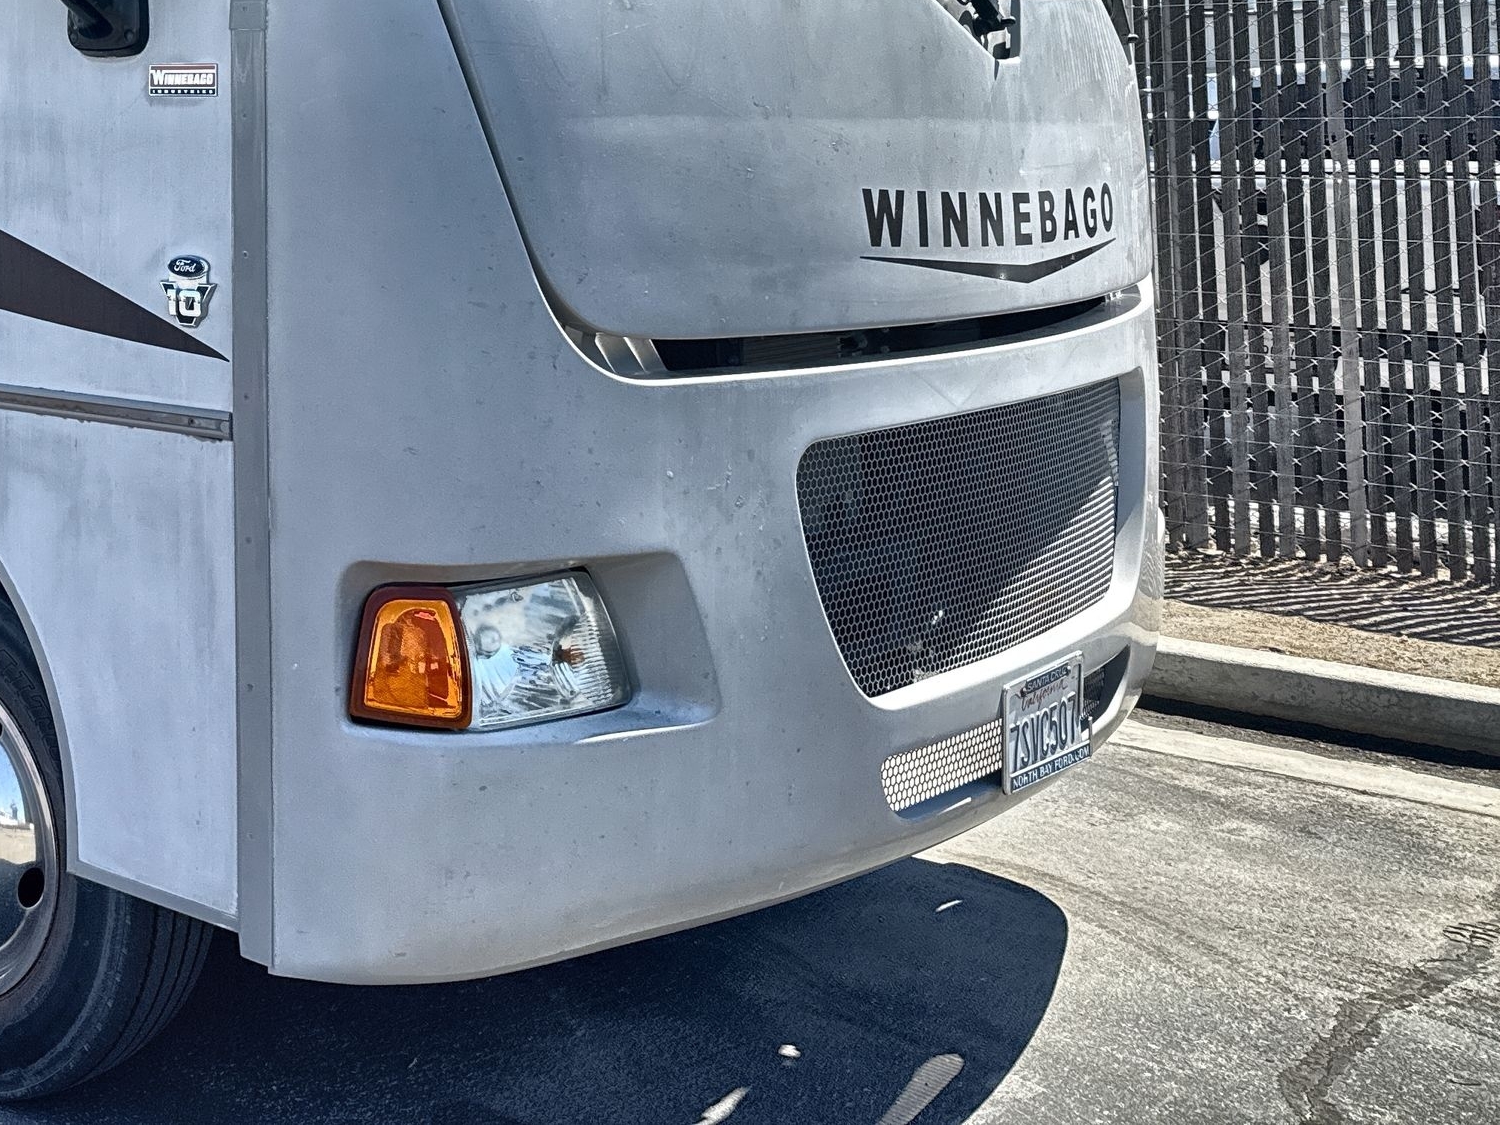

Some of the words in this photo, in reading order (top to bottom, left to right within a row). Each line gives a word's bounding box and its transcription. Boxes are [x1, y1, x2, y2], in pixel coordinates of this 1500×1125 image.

[151, 69, 214, 86] WINNEBAGO
[861, 182, 1114, 248] WINNEBAGO
[173, 259, 197, 273] Ford
[1027, 674, 1051, 692] SANTA
[1010, 690, 1077, 774] 7SVC507
[1012, 768, 1038, 790] NORTH
[1040, 763, 1054, 778] BAY
